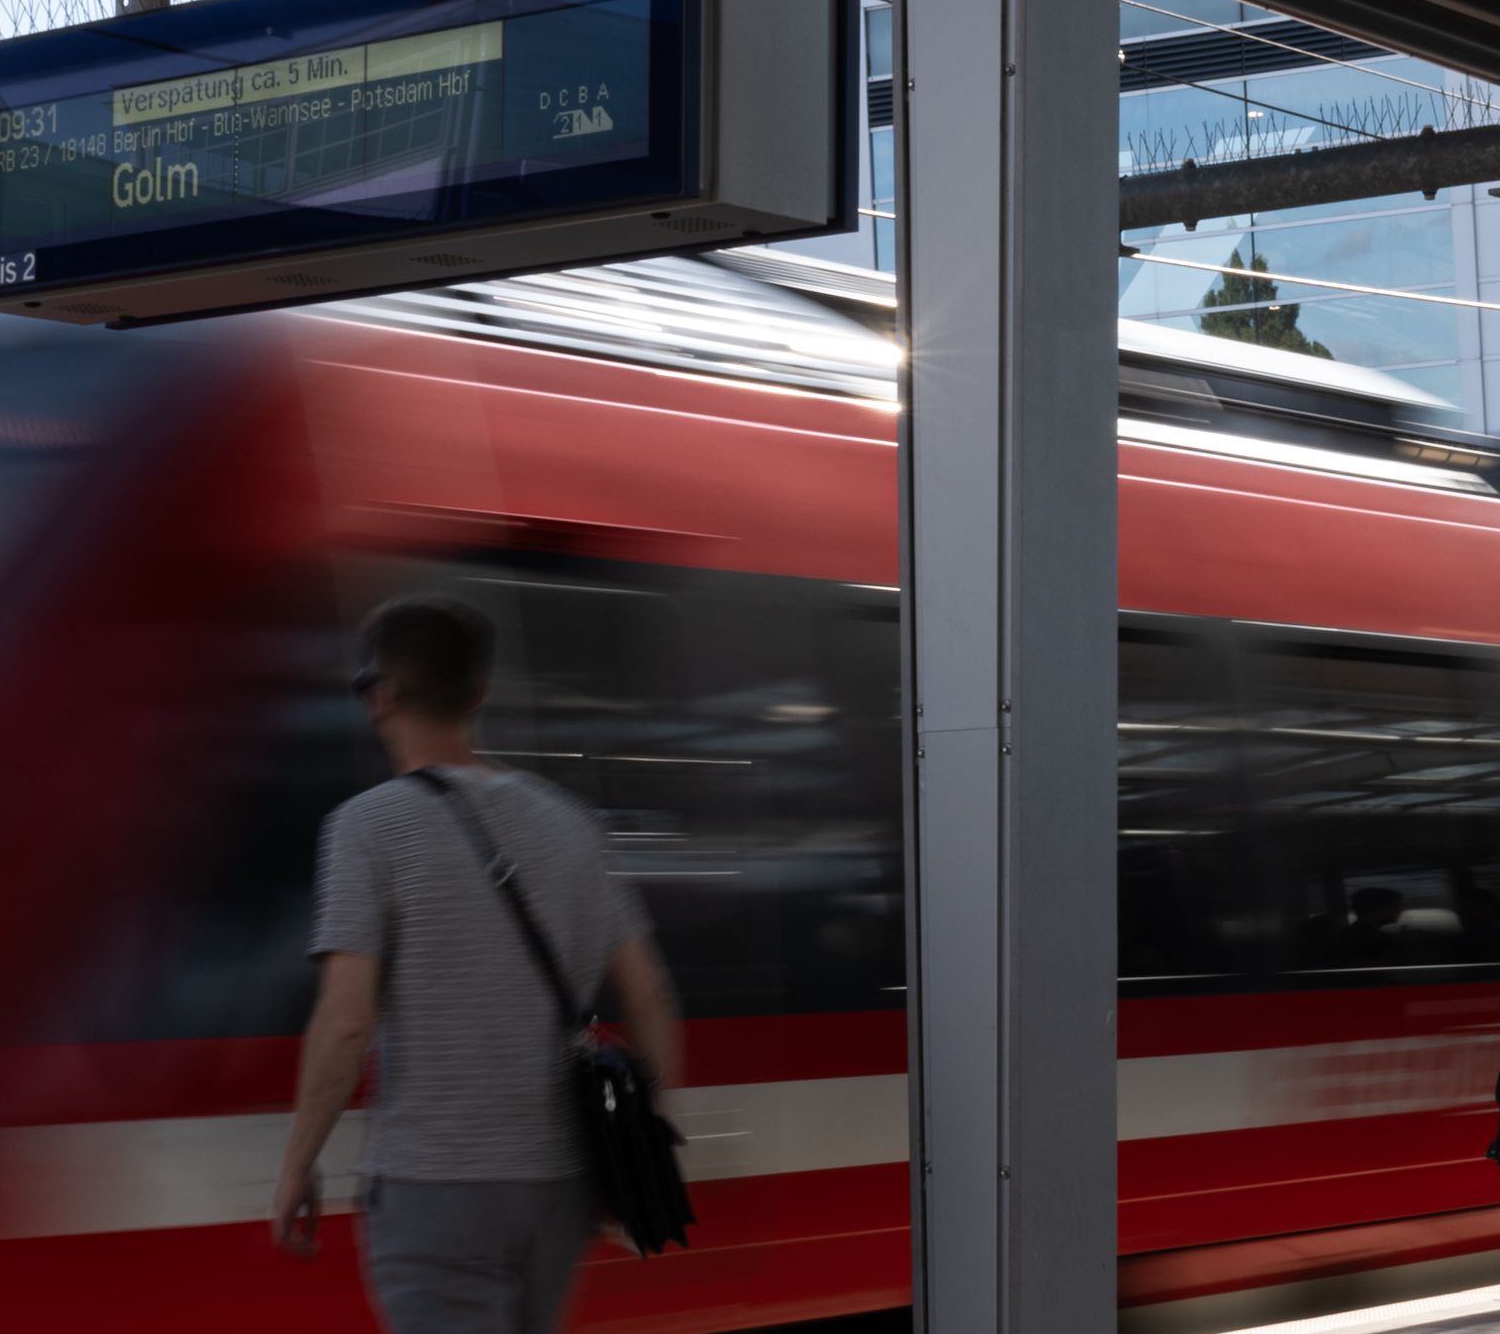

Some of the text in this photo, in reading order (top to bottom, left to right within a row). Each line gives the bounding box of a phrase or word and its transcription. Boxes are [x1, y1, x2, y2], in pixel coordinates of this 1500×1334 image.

[122, 56, 348, 114] Verspätung ca. 5 Min.
[540, 82, 609, 110] D C B A
[113, 124, 161, 153] Berlin
[166, 117, 196, 145] Hbf
[214, 97, 332, 137] Bln-Wannsee
[351, 78, 433, 112] Potsdam
[438, 69, 471, 98] Hbf
[19, 145, 40, 170] 23
[59, 133, 106, 163] 18148
[112, 156, 199, 208] Golm
[22, 253, 36, 281] 2
